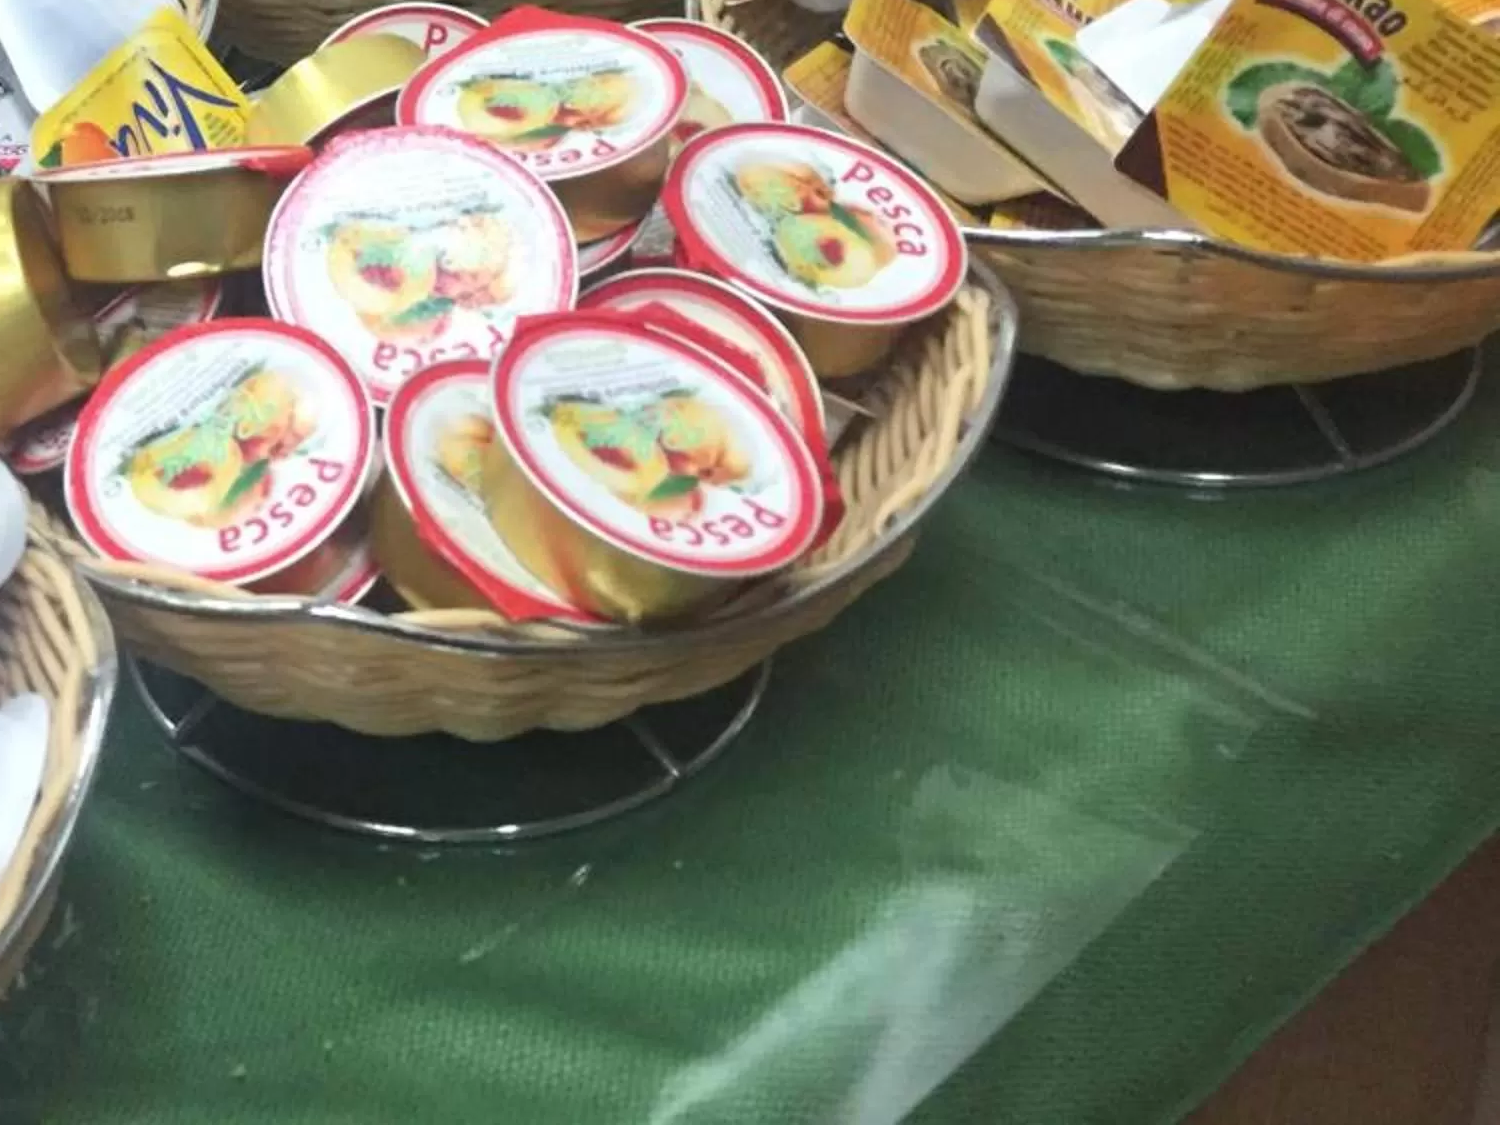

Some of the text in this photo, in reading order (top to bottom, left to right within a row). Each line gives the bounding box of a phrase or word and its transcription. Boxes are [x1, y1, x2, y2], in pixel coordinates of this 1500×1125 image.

[842, 160, 929, 258] Pesca
[218, 456, 345, 553] Pesca
[649, 498, 786, 547] Pesca
